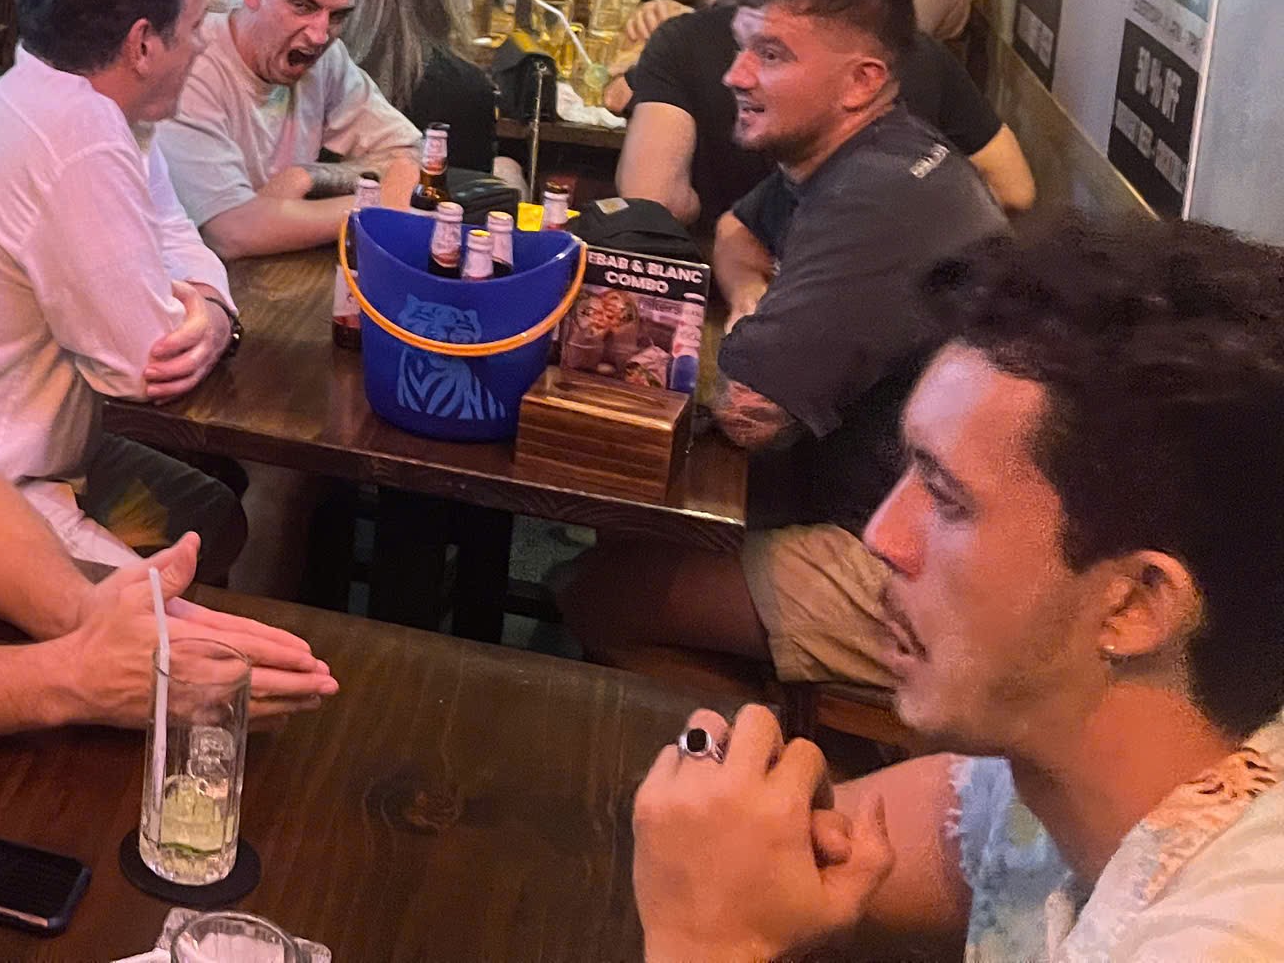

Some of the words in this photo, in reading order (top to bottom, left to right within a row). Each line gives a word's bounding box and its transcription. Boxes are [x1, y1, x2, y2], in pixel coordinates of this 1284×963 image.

[588, 251, 629, 269] EBAB
[630, 259, 644, 273] &
[647, 262, 703, 283] BLANC
[605, 271, 669, 294] COMBO
